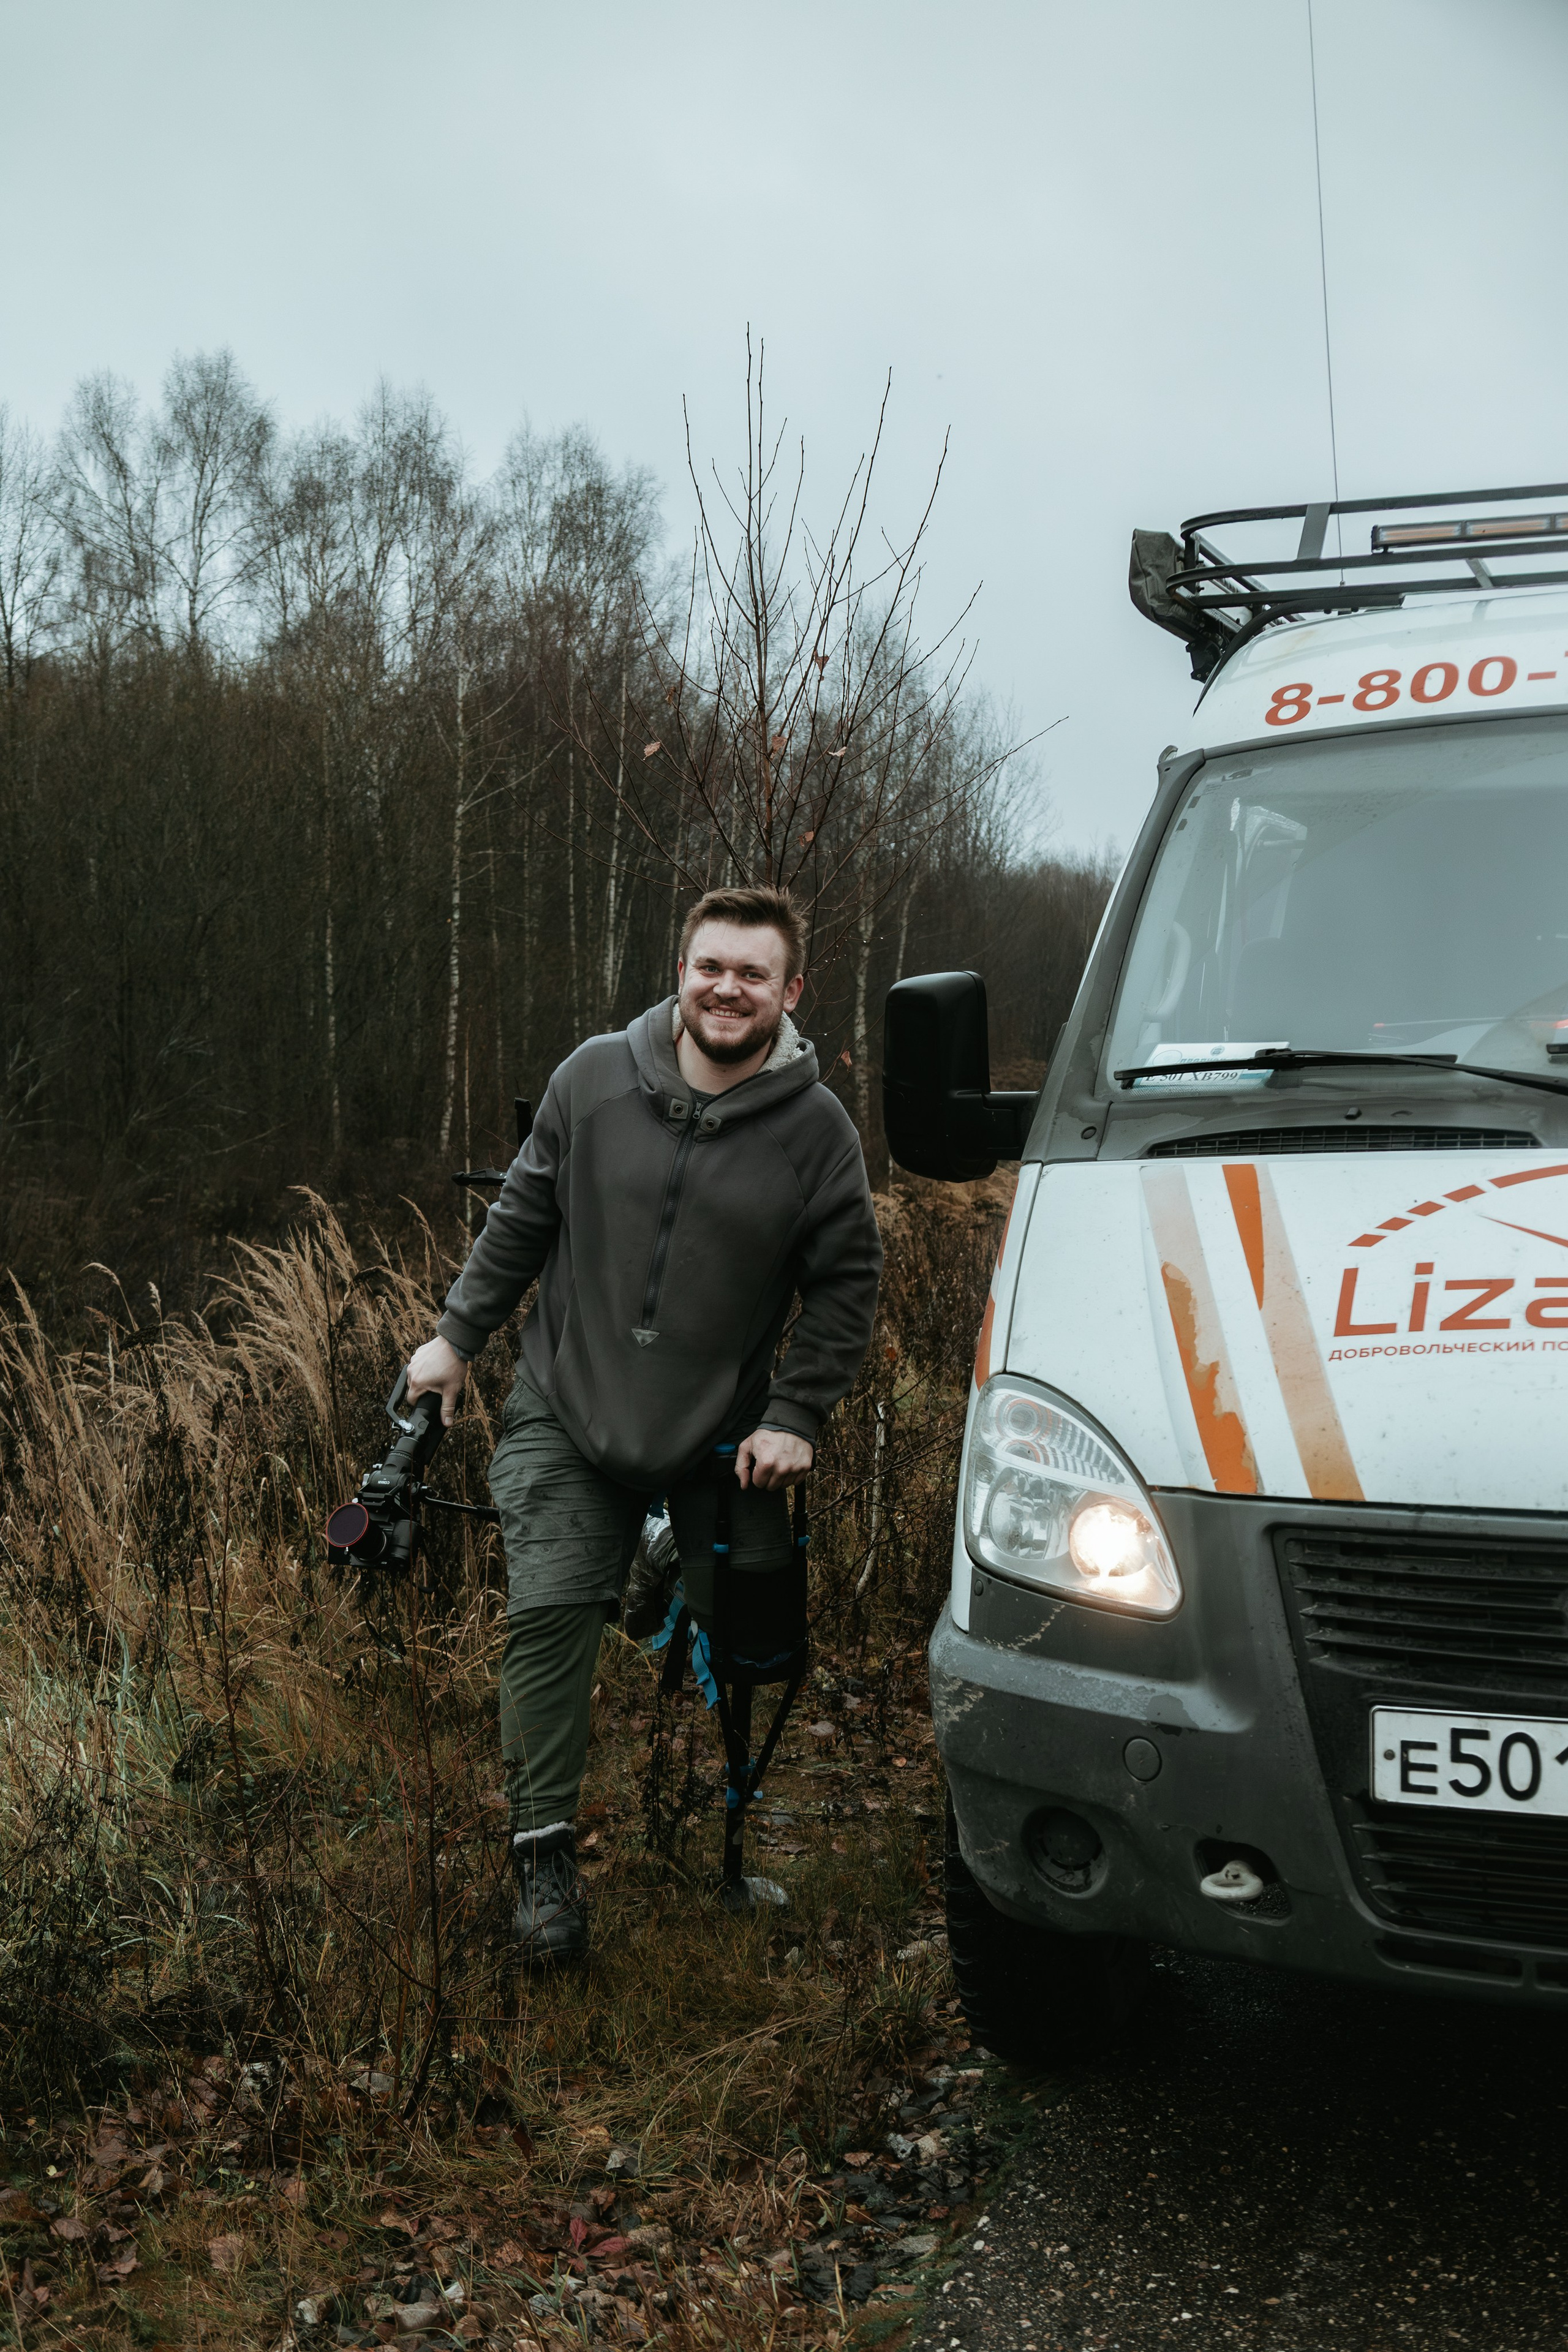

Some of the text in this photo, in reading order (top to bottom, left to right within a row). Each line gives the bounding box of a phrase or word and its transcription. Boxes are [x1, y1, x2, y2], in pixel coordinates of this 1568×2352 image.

[1265, 650, 1568, 725] 8-800-
[1329, 1339, 1535, 1362] ДОБРОВОЛЬЧЕСКИЙ
[1400, 1727, 1568, 1801] Е50
